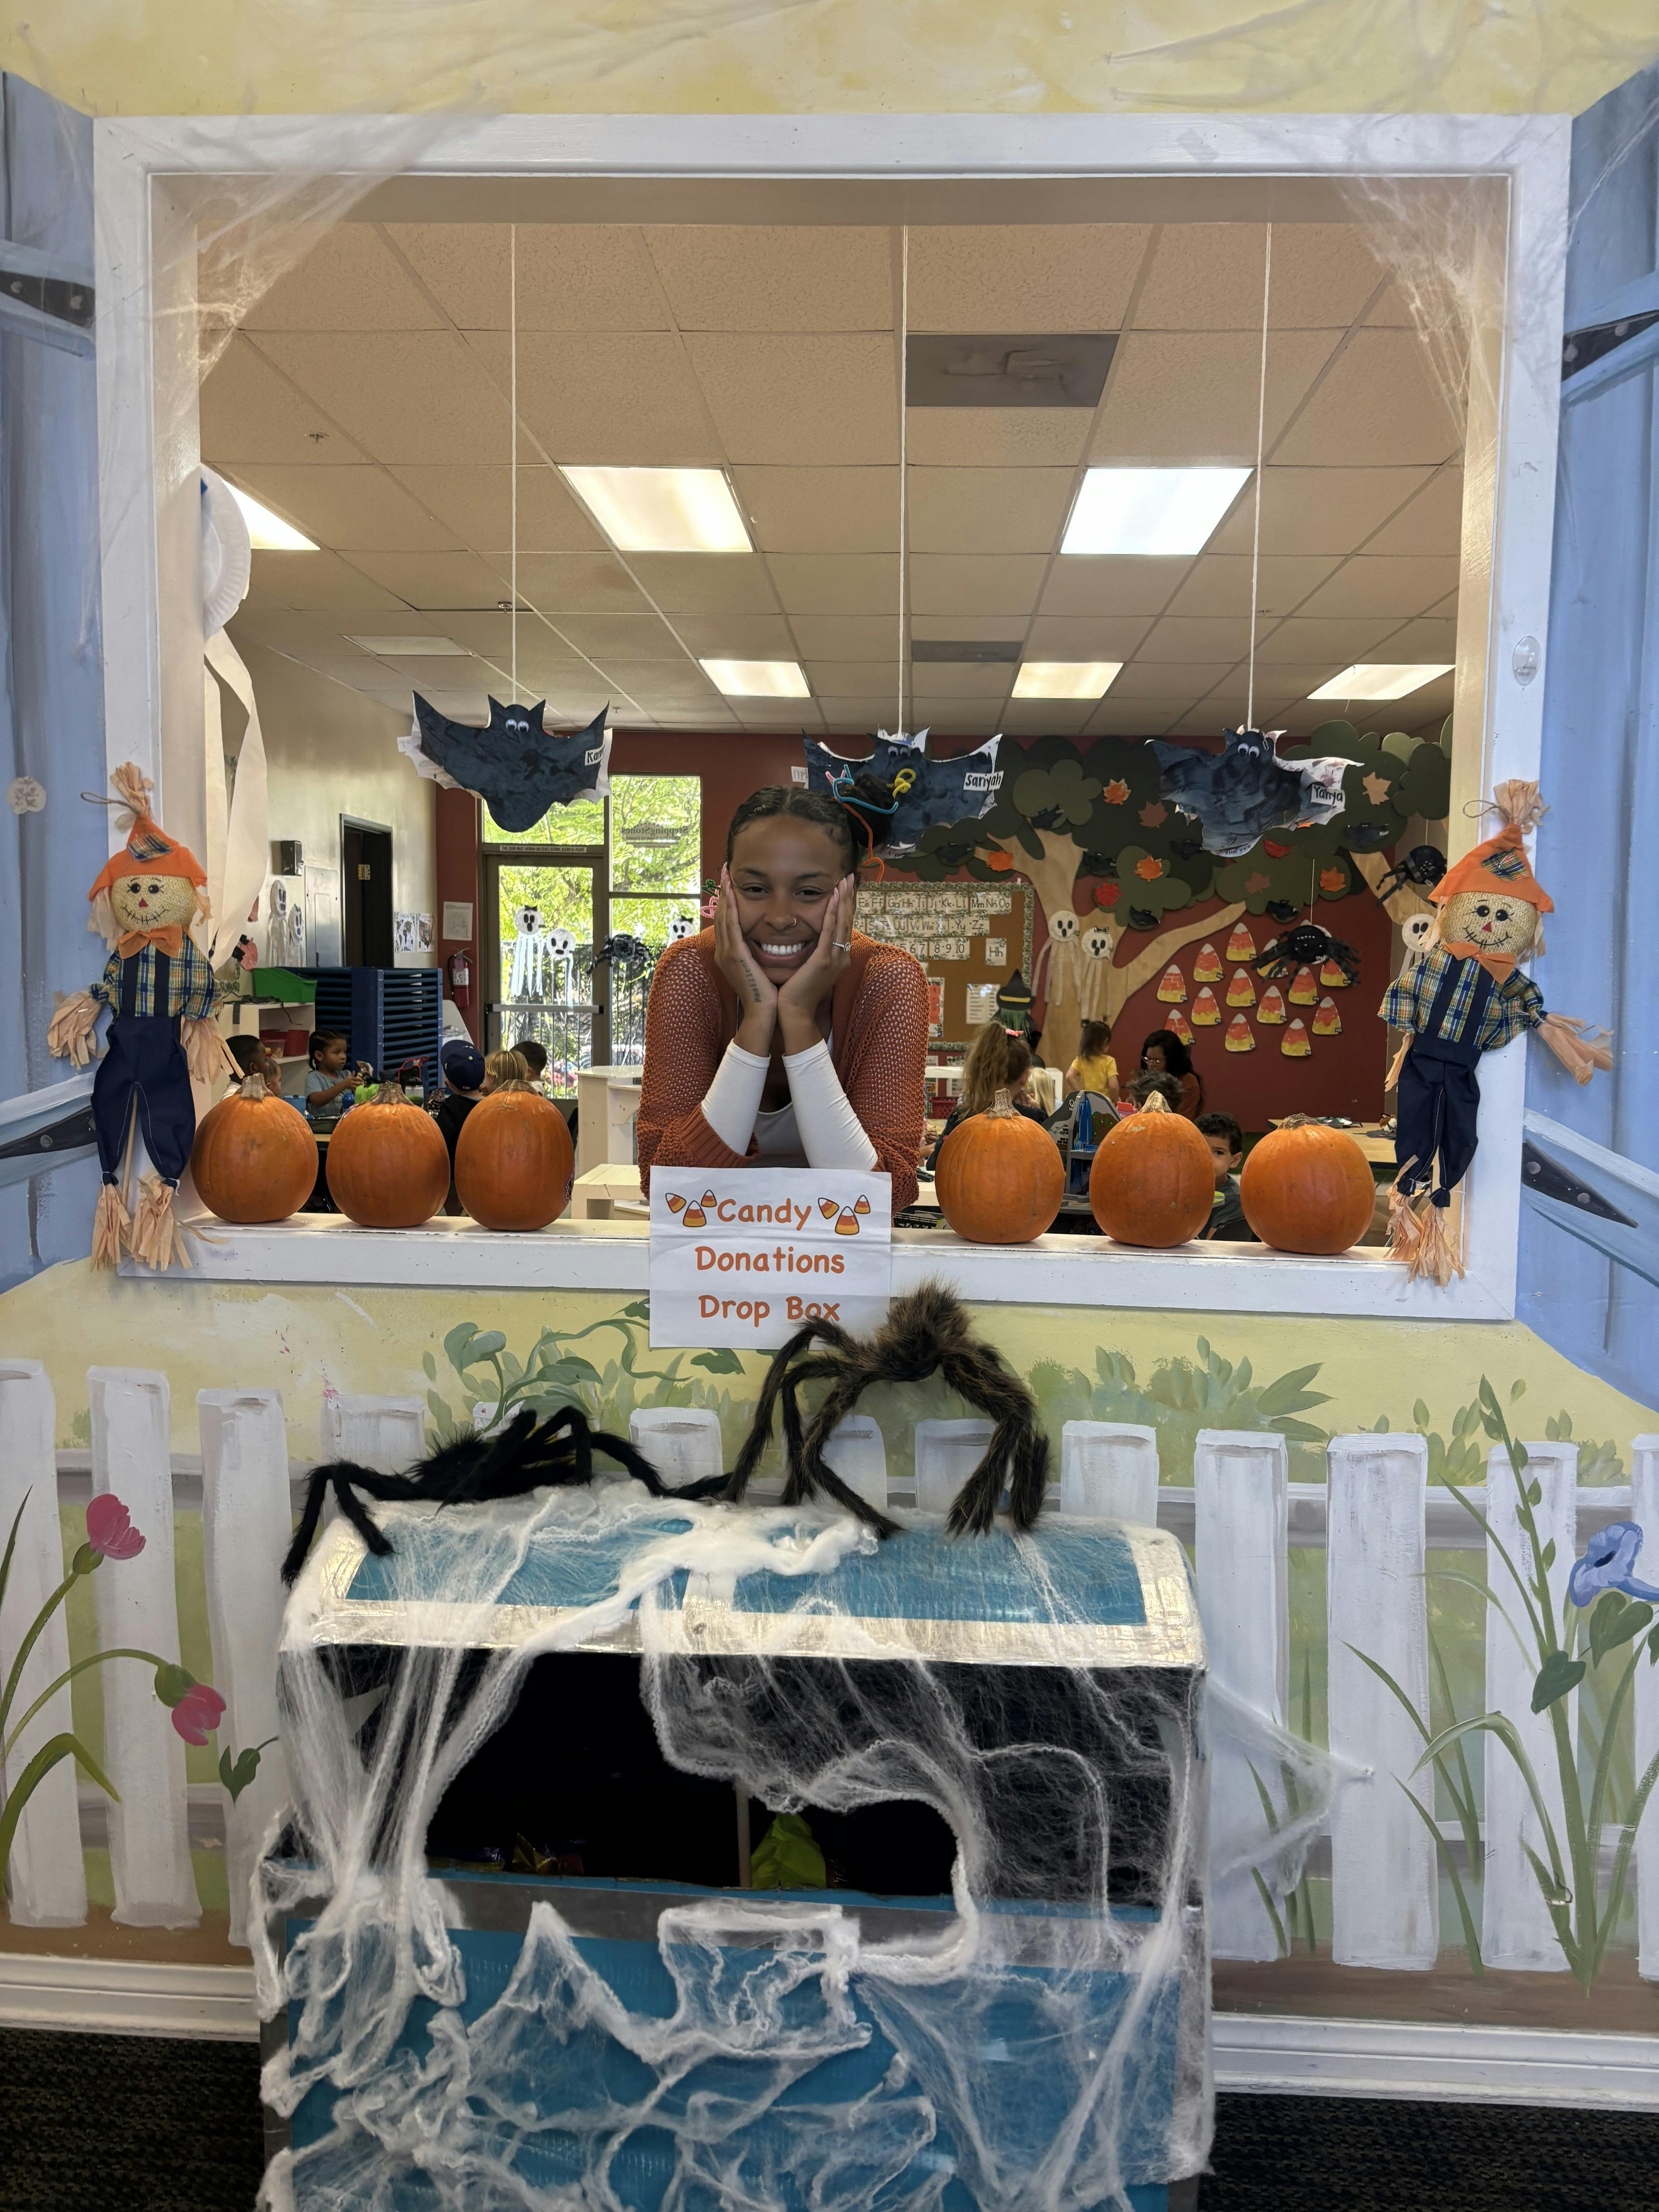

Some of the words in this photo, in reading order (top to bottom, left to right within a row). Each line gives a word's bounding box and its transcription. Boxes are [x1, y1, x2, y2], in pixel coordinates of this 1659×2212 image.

[872, 898, 883, 907] Ff
[888, 898, 900, 910] Gg
[910, 943, 916, 953] 6
[919, 944, 925, 953] 7
[934, 944, 940, 953] 8
[946, 944, 951, 953] 9
[956, 944, 964, 953] 10
[989, 946, 1003, 957] Hh
[717, 1198, 812, 1231] Candy
[695, 1245, 845, 1274] Donations
[698, 1295, 770, 1328] Drop
[785, 1296, 840, 1322] Box
